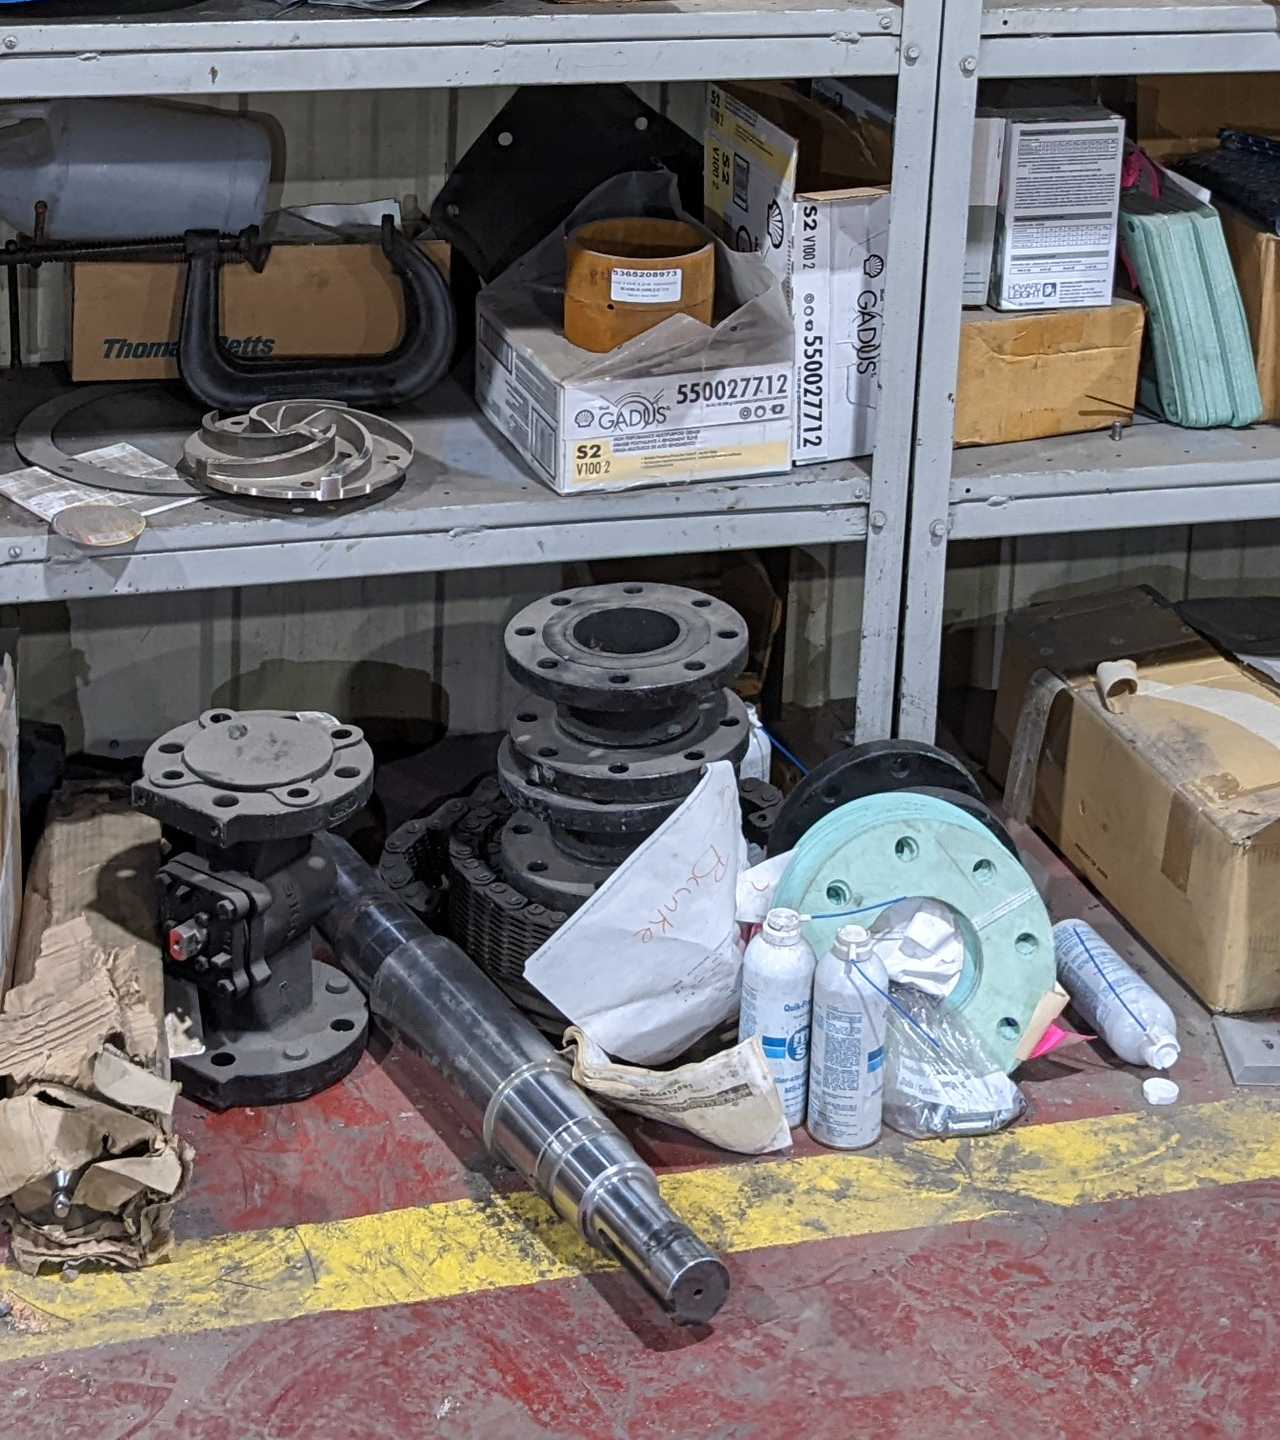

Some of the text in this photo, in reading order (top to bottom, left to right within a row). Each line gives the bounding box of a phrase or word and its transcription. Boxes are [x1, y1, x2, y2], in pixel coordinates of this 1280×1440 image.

[803, 205, 818, 232] S2
[802, 235, 816, 262] V100
[855, 288, 881, 376] GADUS
[103, 337, 180, 360] Thoma
[675, 373, 789, 405] 550027712
[802, 335, 824, 449] 550027712
[598, 405, 668, 432] GADUS
[576, 444, 602, 460] S2
[576, 461, 610, 477] V100 2
